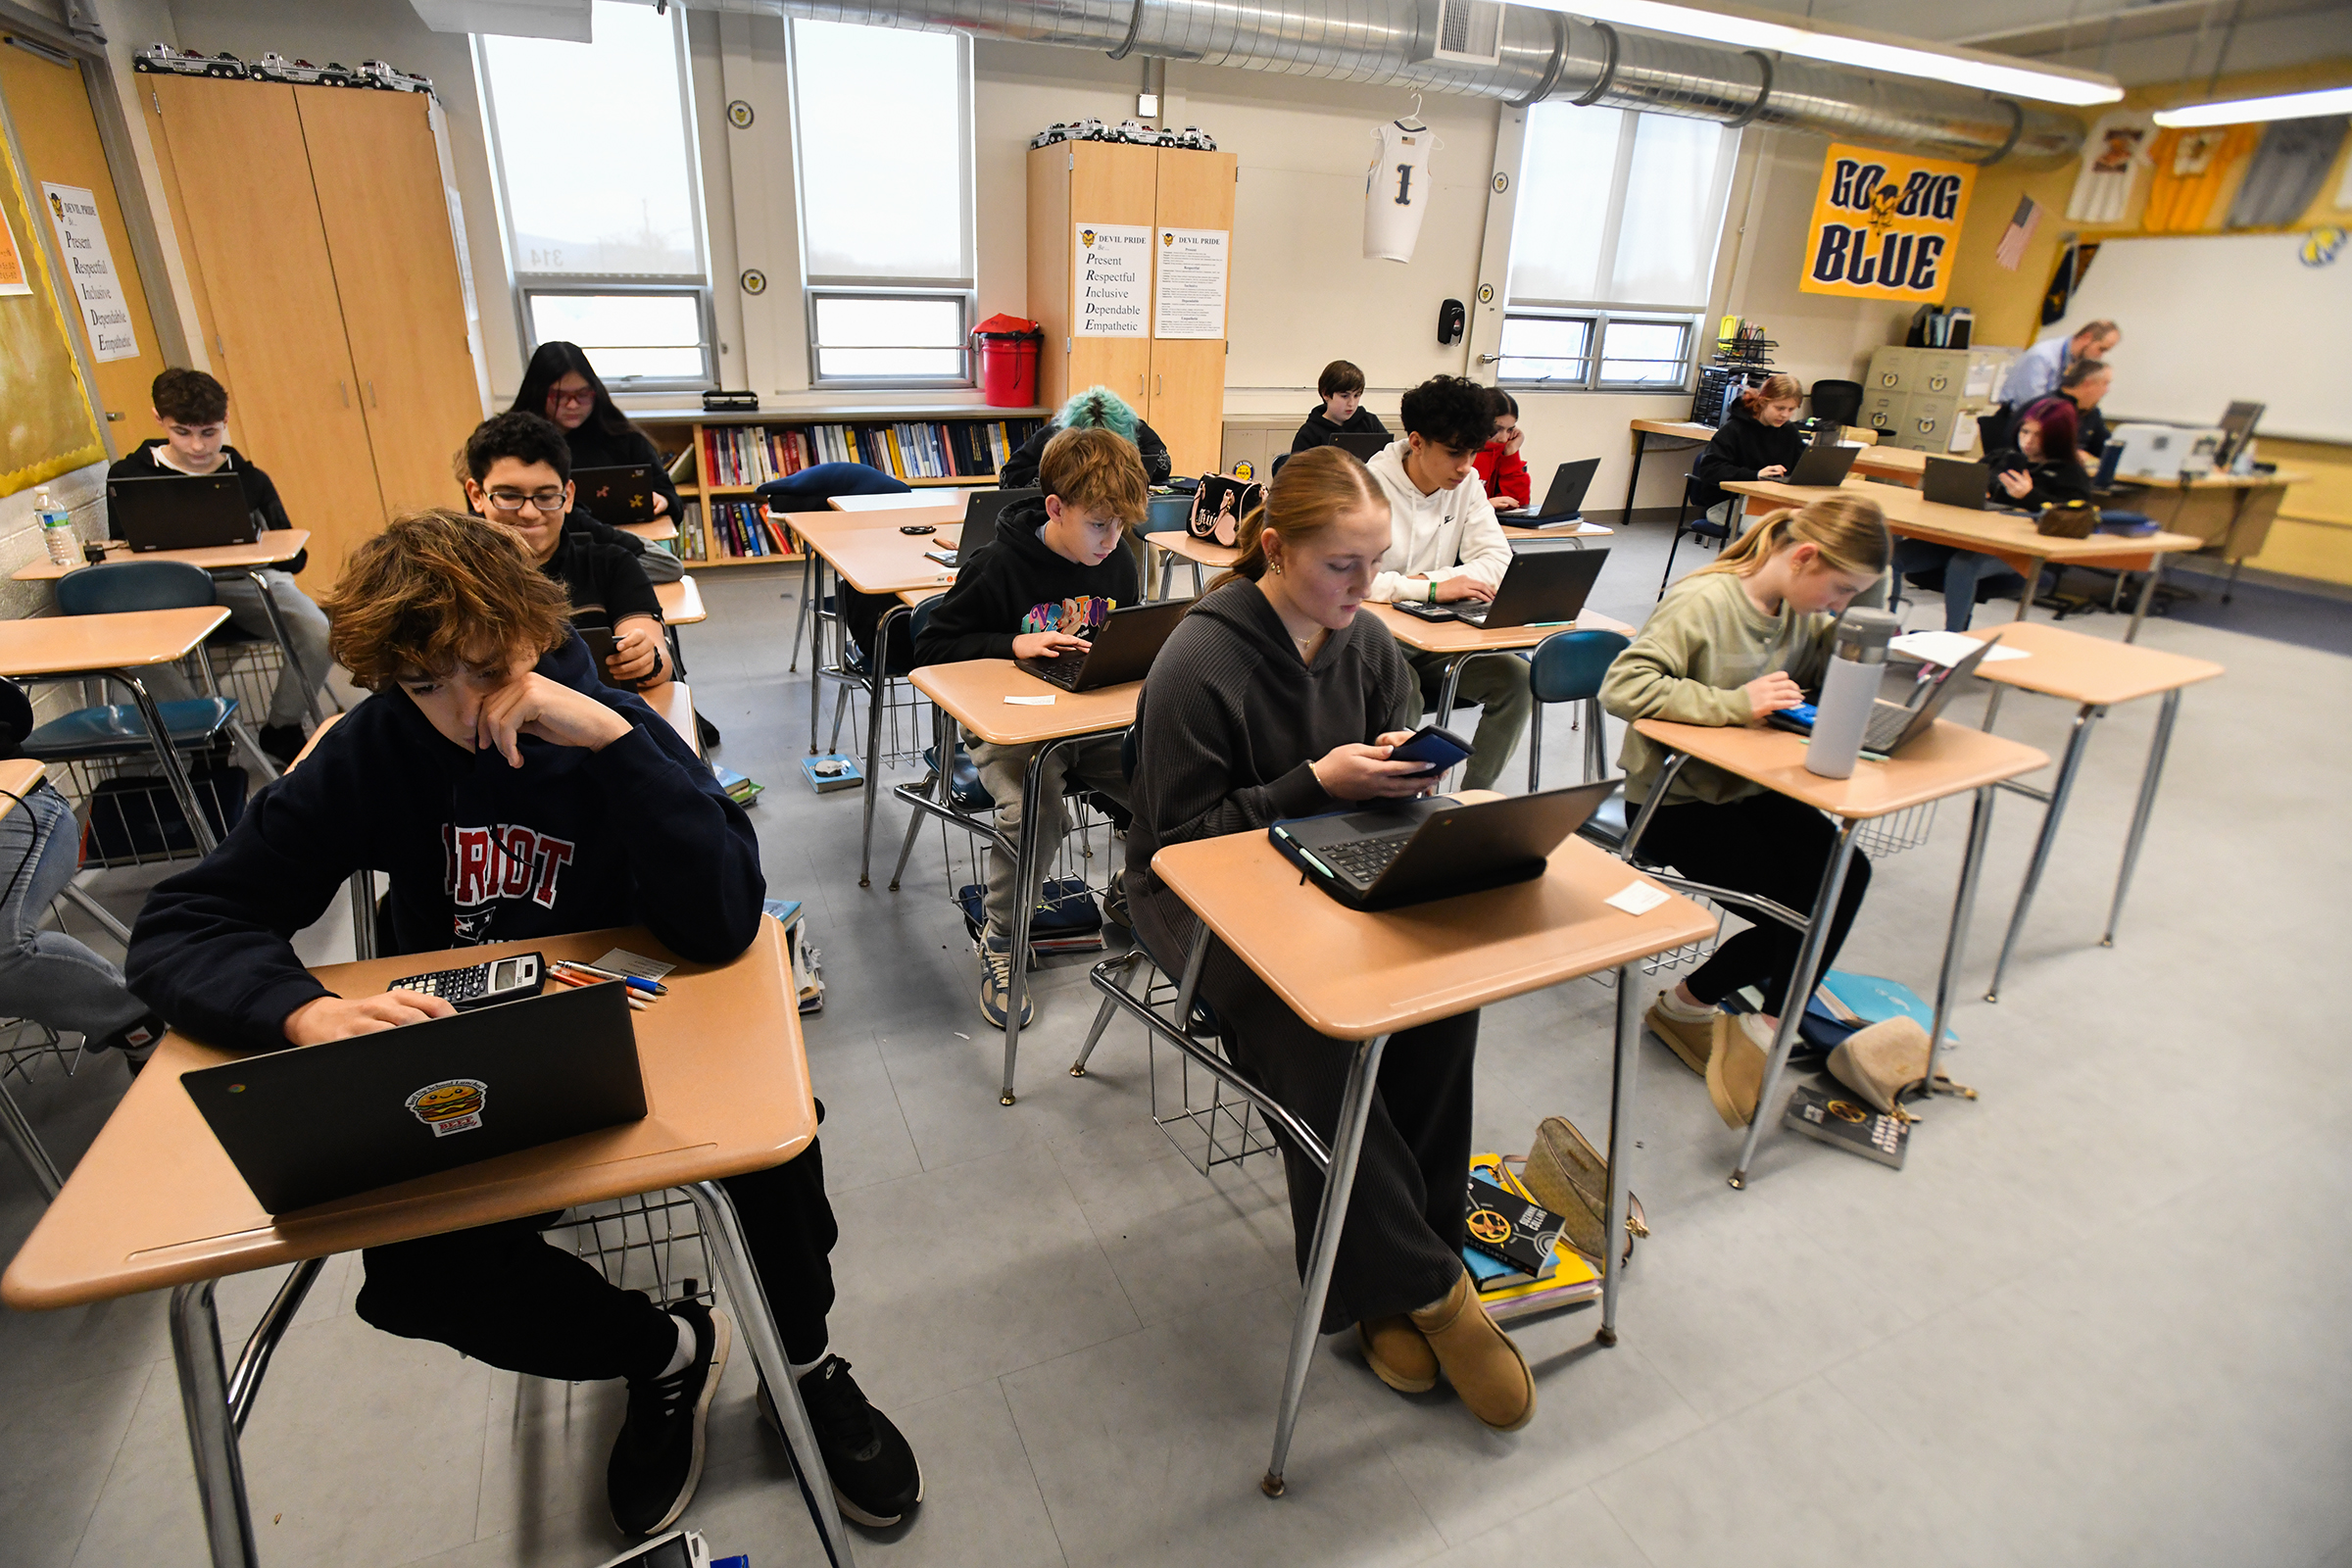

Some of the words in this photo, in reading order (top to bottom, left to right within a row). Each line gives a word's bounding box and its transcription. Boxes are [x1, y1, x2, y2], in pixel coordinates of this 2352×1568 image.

[1830, 159, 1886, 211] GO
[1896, 171, 1962, 220] BIG
[65, 230, 92, 249] Present
[1099, 235, 1122, 244] DEVIL
[1123, 236, 1147, 245] PRIDE
[1178, 236, 1200, 245] DEVIL
[1086, 253, 1122, 267] Present
[1813, 223, 1945, 290] BLUE
[73, 257, 108, 278] Respectful
[1086, 270, 1136, 284] Respectful
[81, 282, 112, 300] Inclusive
[1086, 286, 1129, 298] Inclusive
[90, 308, 127, 329] Dependable
[1085, 303, 1141, 318] Dependable
[1085, 319, 1139, 333] Empathetic
[98, 333, 131, 353] Empathetic
[441, 823, 575, 910] RIOT
[1529, 1208, 1548, 1232] COLLINS
